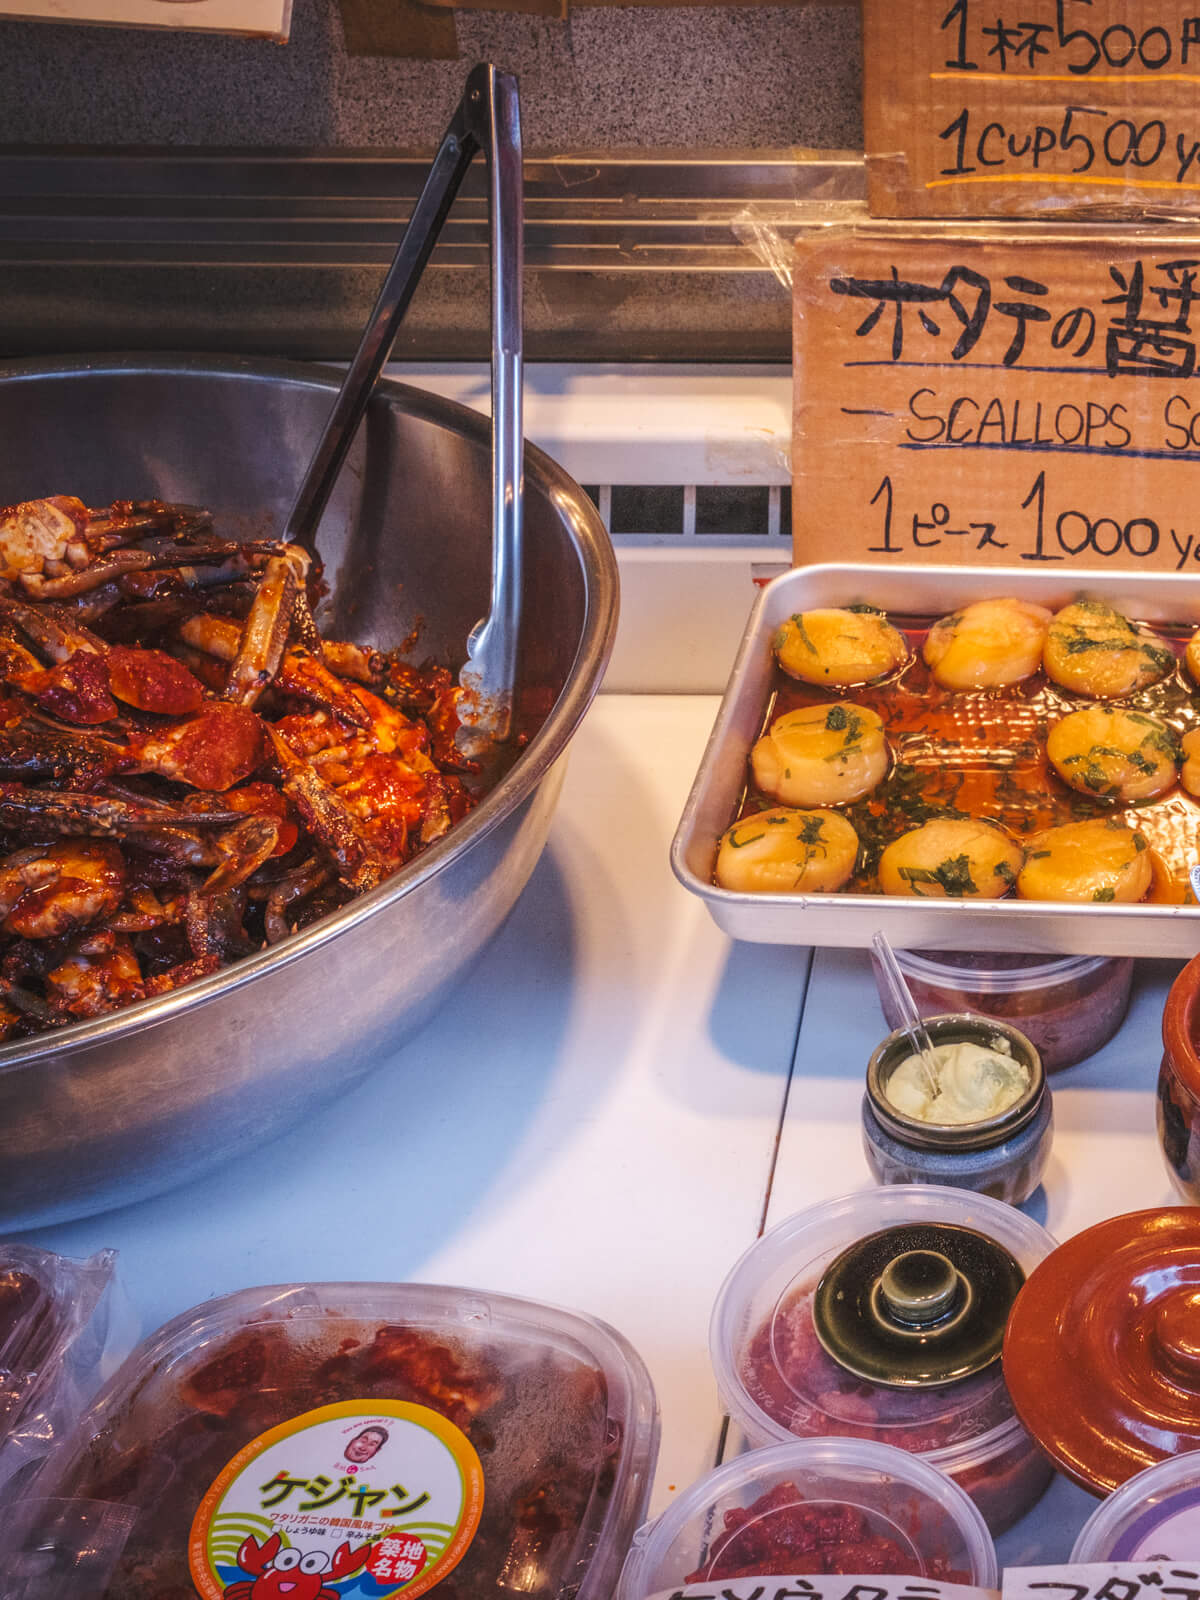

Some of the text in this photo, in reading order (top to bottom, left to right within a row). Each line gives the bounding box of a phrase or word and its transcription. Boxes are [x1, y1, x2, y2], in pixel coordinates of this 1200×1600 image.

[905, 387, 1132, 448] SCALLOPS
[1020, 470, 1161, 561] 1000
[259, 1469, 431, 1518] ケジャン
[371, 1557, 417, 1581] 名物
[378, 1537, 425, 1561] 築地
